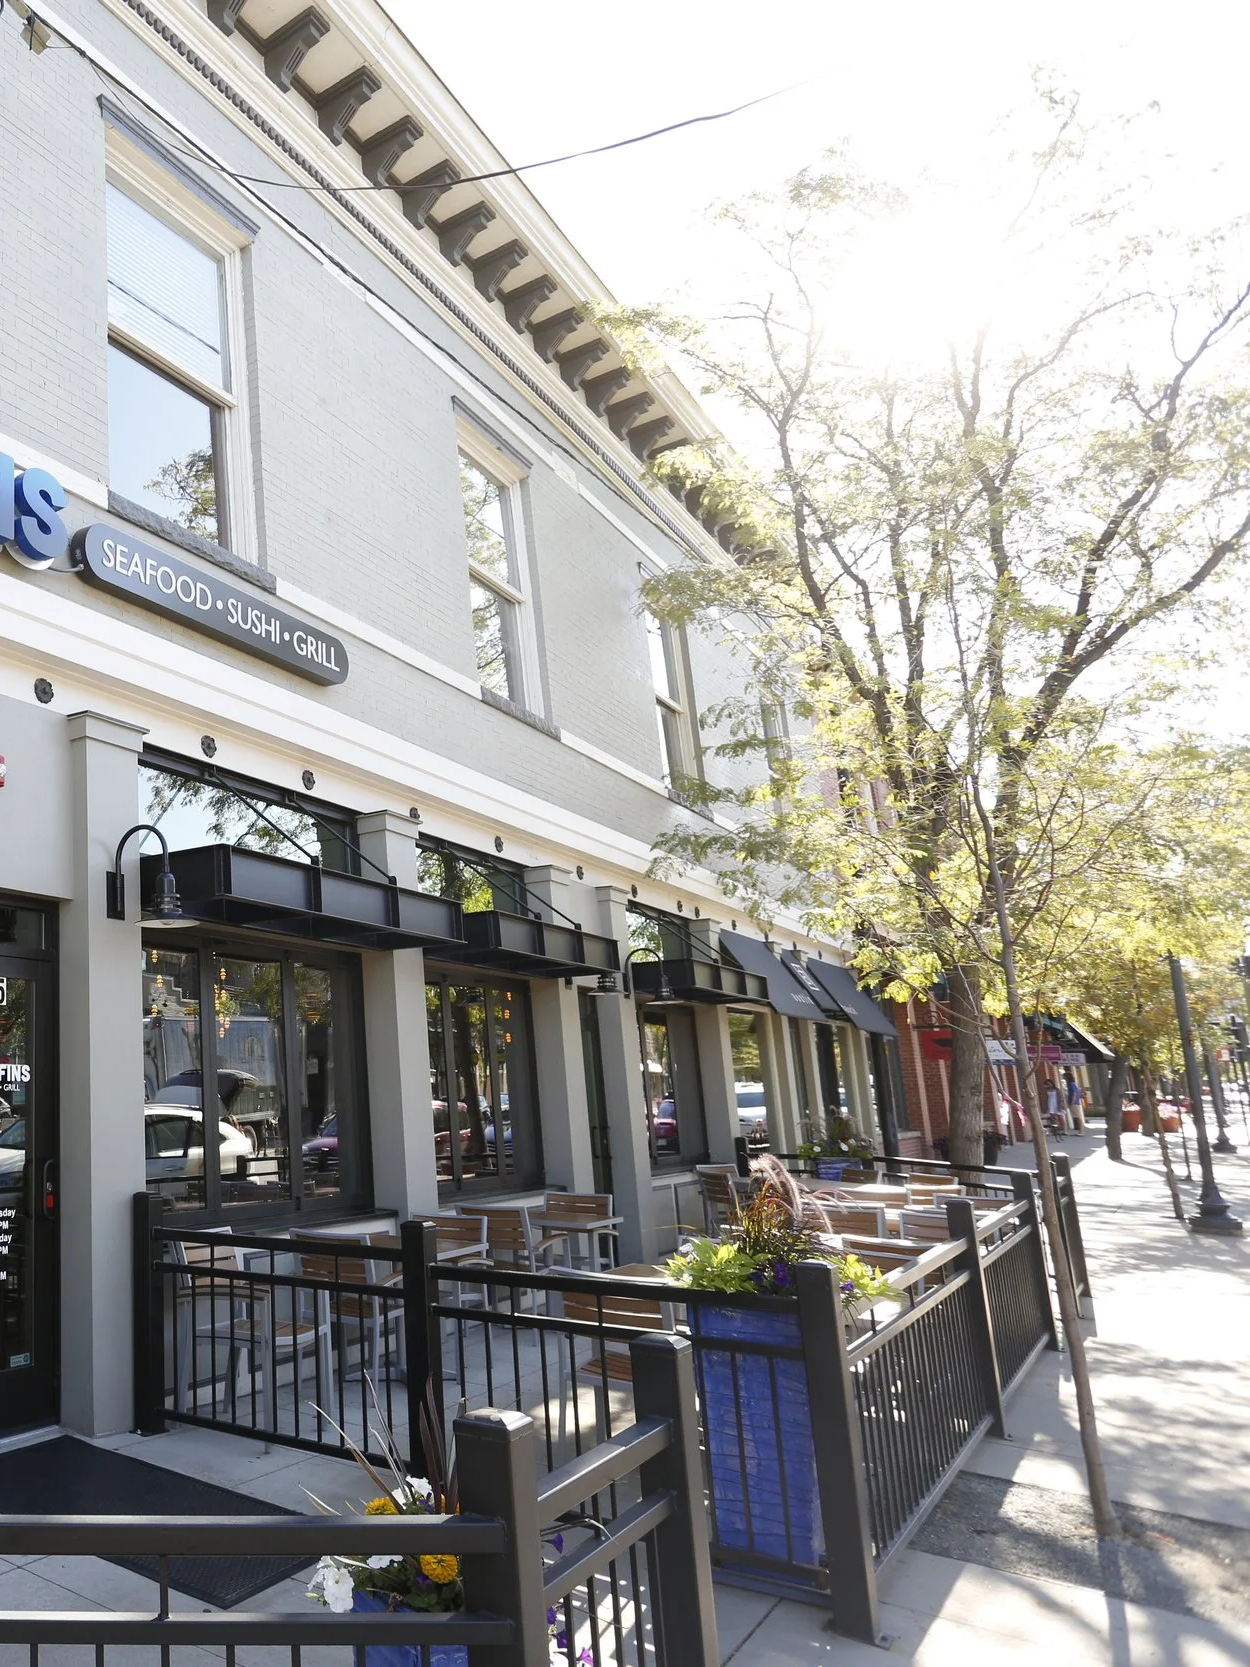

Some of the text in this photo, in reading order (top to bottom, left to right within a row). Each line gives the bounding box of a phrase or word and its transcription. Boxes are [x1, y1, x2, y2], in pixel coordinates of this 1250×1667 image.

[101, 539, 341, 673] SEAFOOD SUSHI GRILL
[3, 1083, 20, 1091] GRILL
